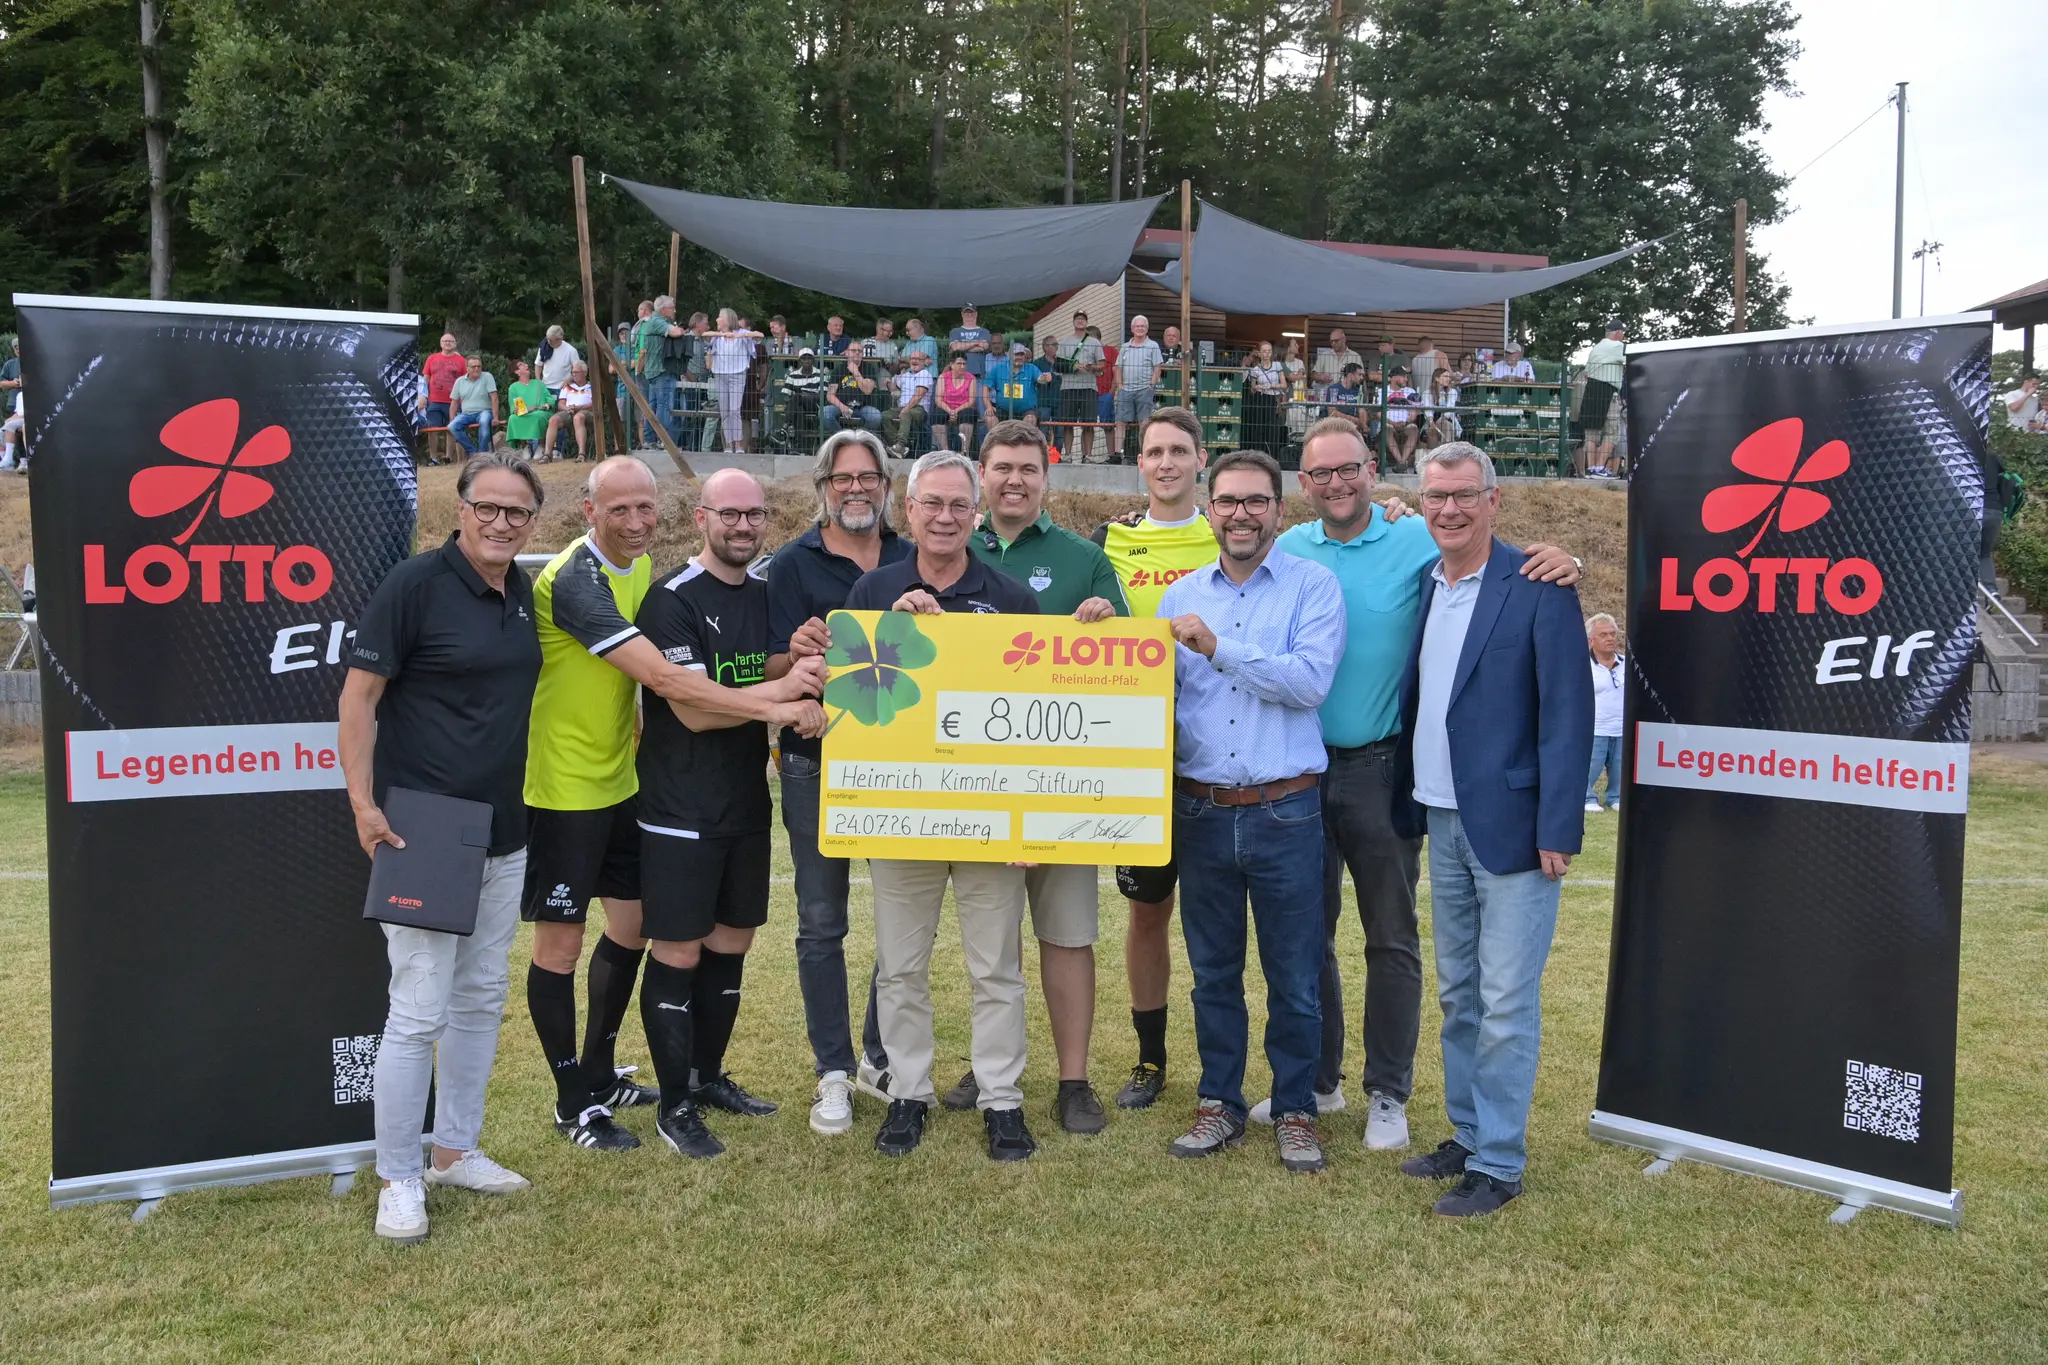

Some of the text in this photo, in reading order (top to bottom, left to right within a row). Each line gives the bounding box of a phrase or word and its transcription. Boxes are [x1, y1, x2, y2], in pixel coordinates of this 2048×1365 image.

[1128, 547, 1148, 557] JAKO
[83, 544, 333, 604] LOTTO
[1153, 568, 1198, 586] LOT
[1659, 557, 1884, 616] LOTTO
[353, 647, 379, 662] JAKO
[1052, 636, 1167, 668] LOTTO
[1815, 630, 1936, 685] Elf
[1051, 673, 1139, 686] Rheinland-Pfalz
[941, 711, 961, 738] €
[935, 747, 954, 755] Betrag
[96, 745, 280, 784] Legenden
[1657, 741, 1956, 792] Legenden helfen!
[841, 765, 1104, 801] Heinrich Kimmle Stiftung
[835, 813, 991, 845] 24.07.26 Lemberg
[825, 838, 847, 846] Datum,
[398, 896, 423, 907] LOTTO
[546, 897, 573, 907] LOTTO
[563, 907, 578, 915] Elf
[606, 1031, 617, 1040] JA
[556, 1056, 577, 1068] JAK
